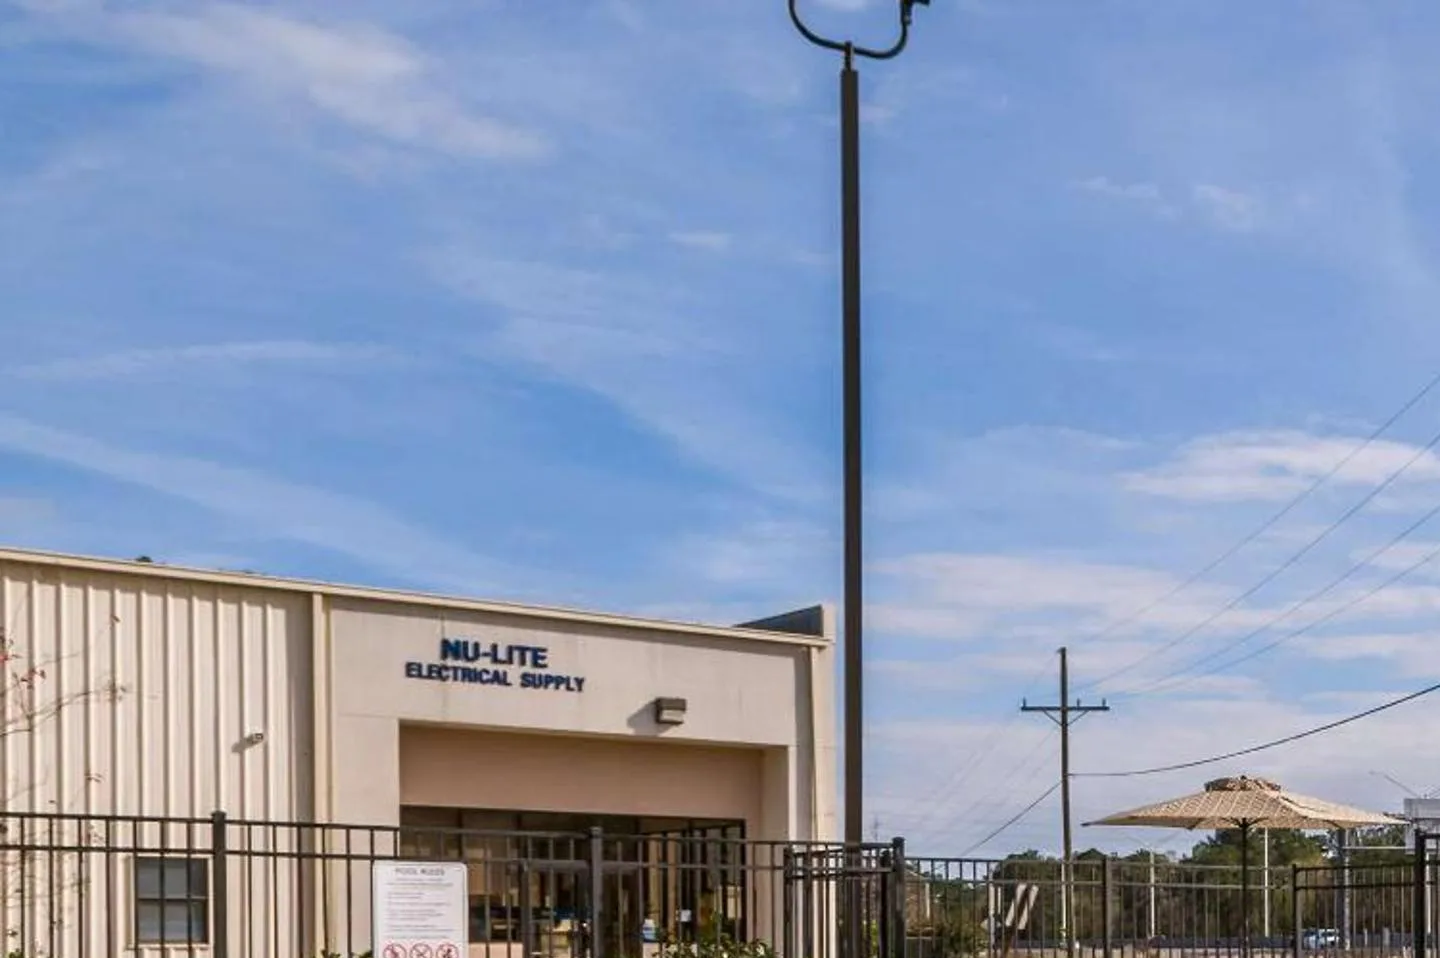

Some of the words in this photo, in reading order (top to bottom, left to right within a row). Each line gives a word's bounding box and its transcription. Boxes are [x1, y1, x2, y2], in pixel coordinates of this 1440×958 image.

[440, 638, 548, 668] NU-LITE
[405, 661, 512, 686] ELECTRICAL
[520, 672, 585, 692] SUPPLY
